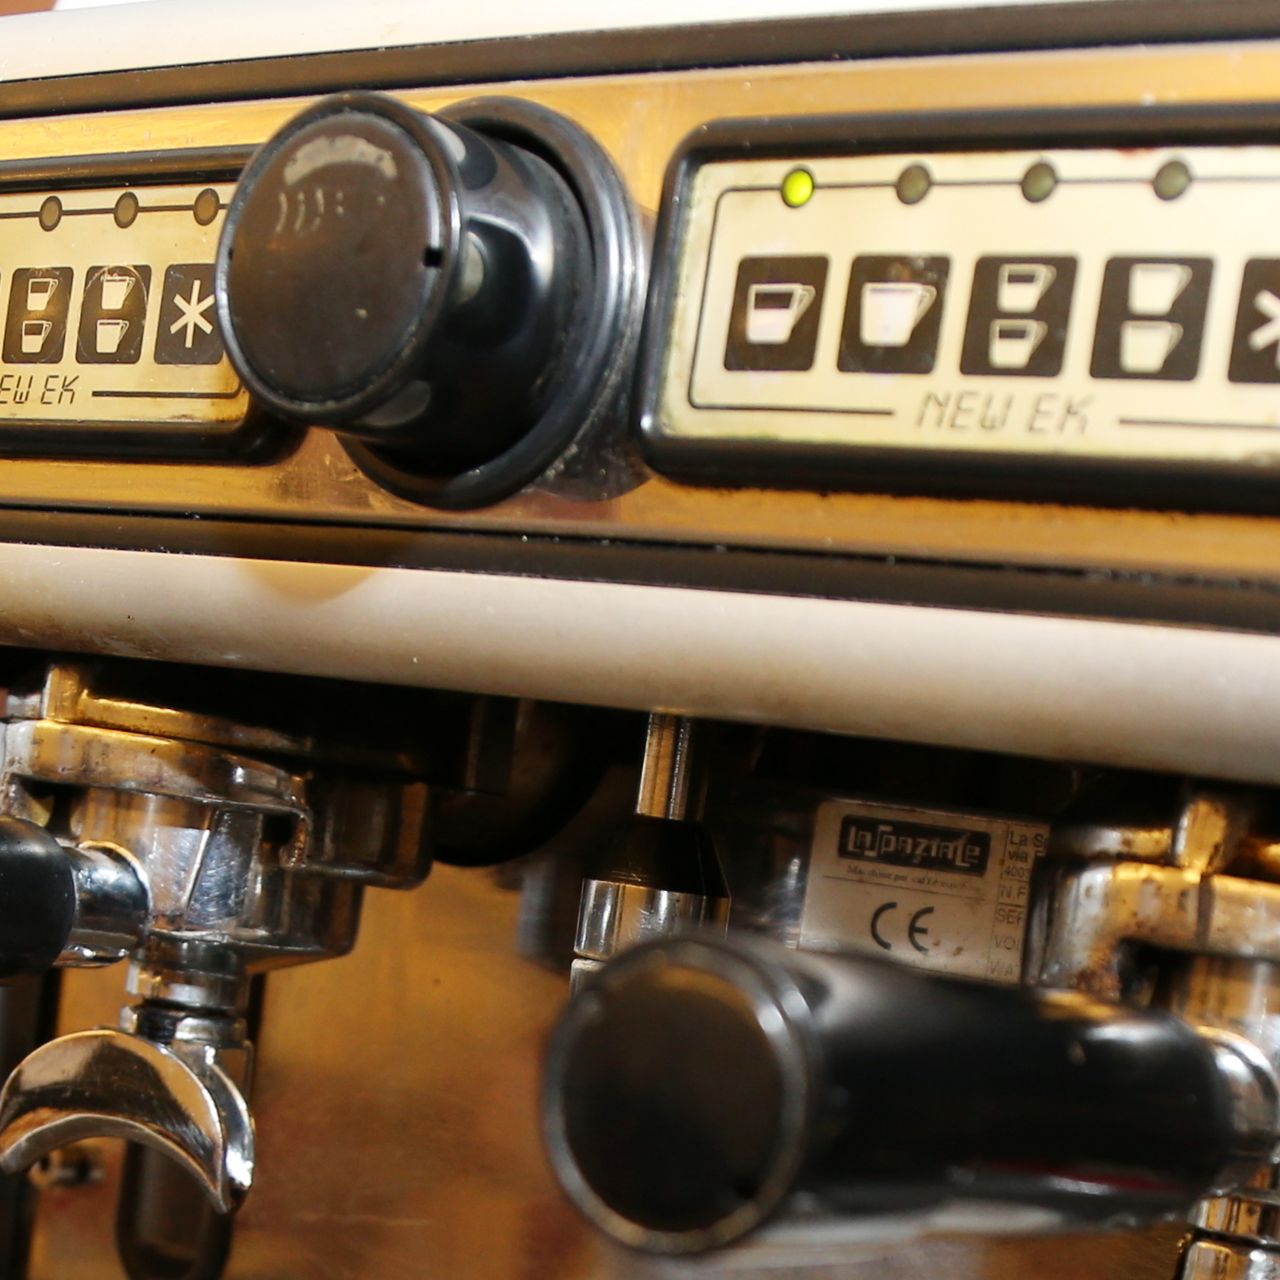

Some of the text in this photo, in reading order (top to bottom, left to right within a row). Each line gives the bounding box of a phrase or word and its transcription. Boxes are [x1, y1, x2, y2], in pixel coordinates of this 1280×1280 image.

[40, 375, 81, 405] EK
[915, 390, 1096, 436] NEW EK
[870, 901, 935, 956] CE
